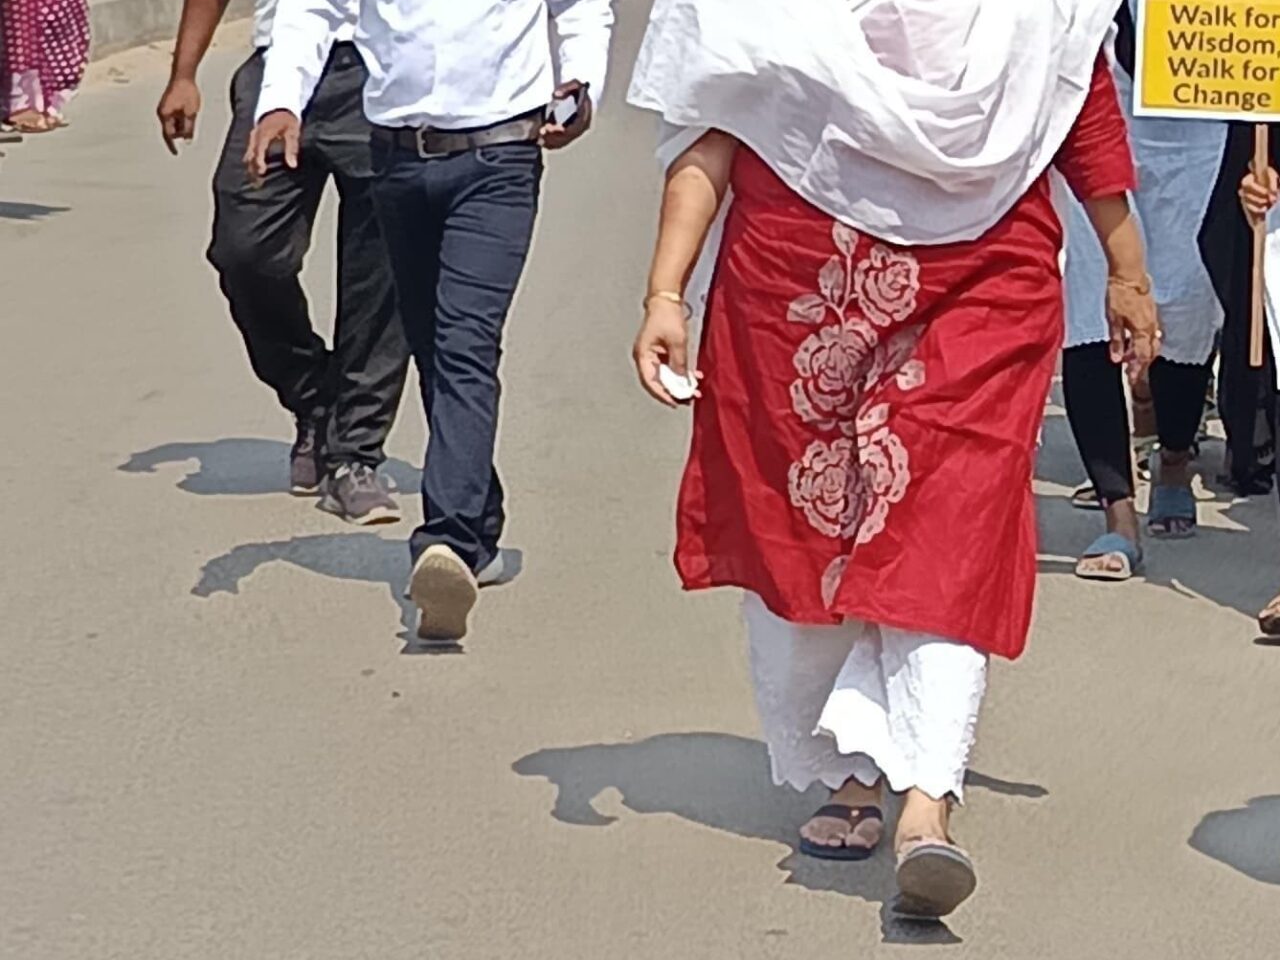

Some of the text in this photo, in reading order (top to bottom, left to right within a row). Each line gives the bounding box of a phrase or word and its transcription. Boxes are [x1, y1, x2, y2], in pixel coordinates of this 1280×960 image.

[1169, 4, 1237, 29] Walk
[1167, 56, 1280, 82] Walk for
[1172, 82, 1272, 112] Change
